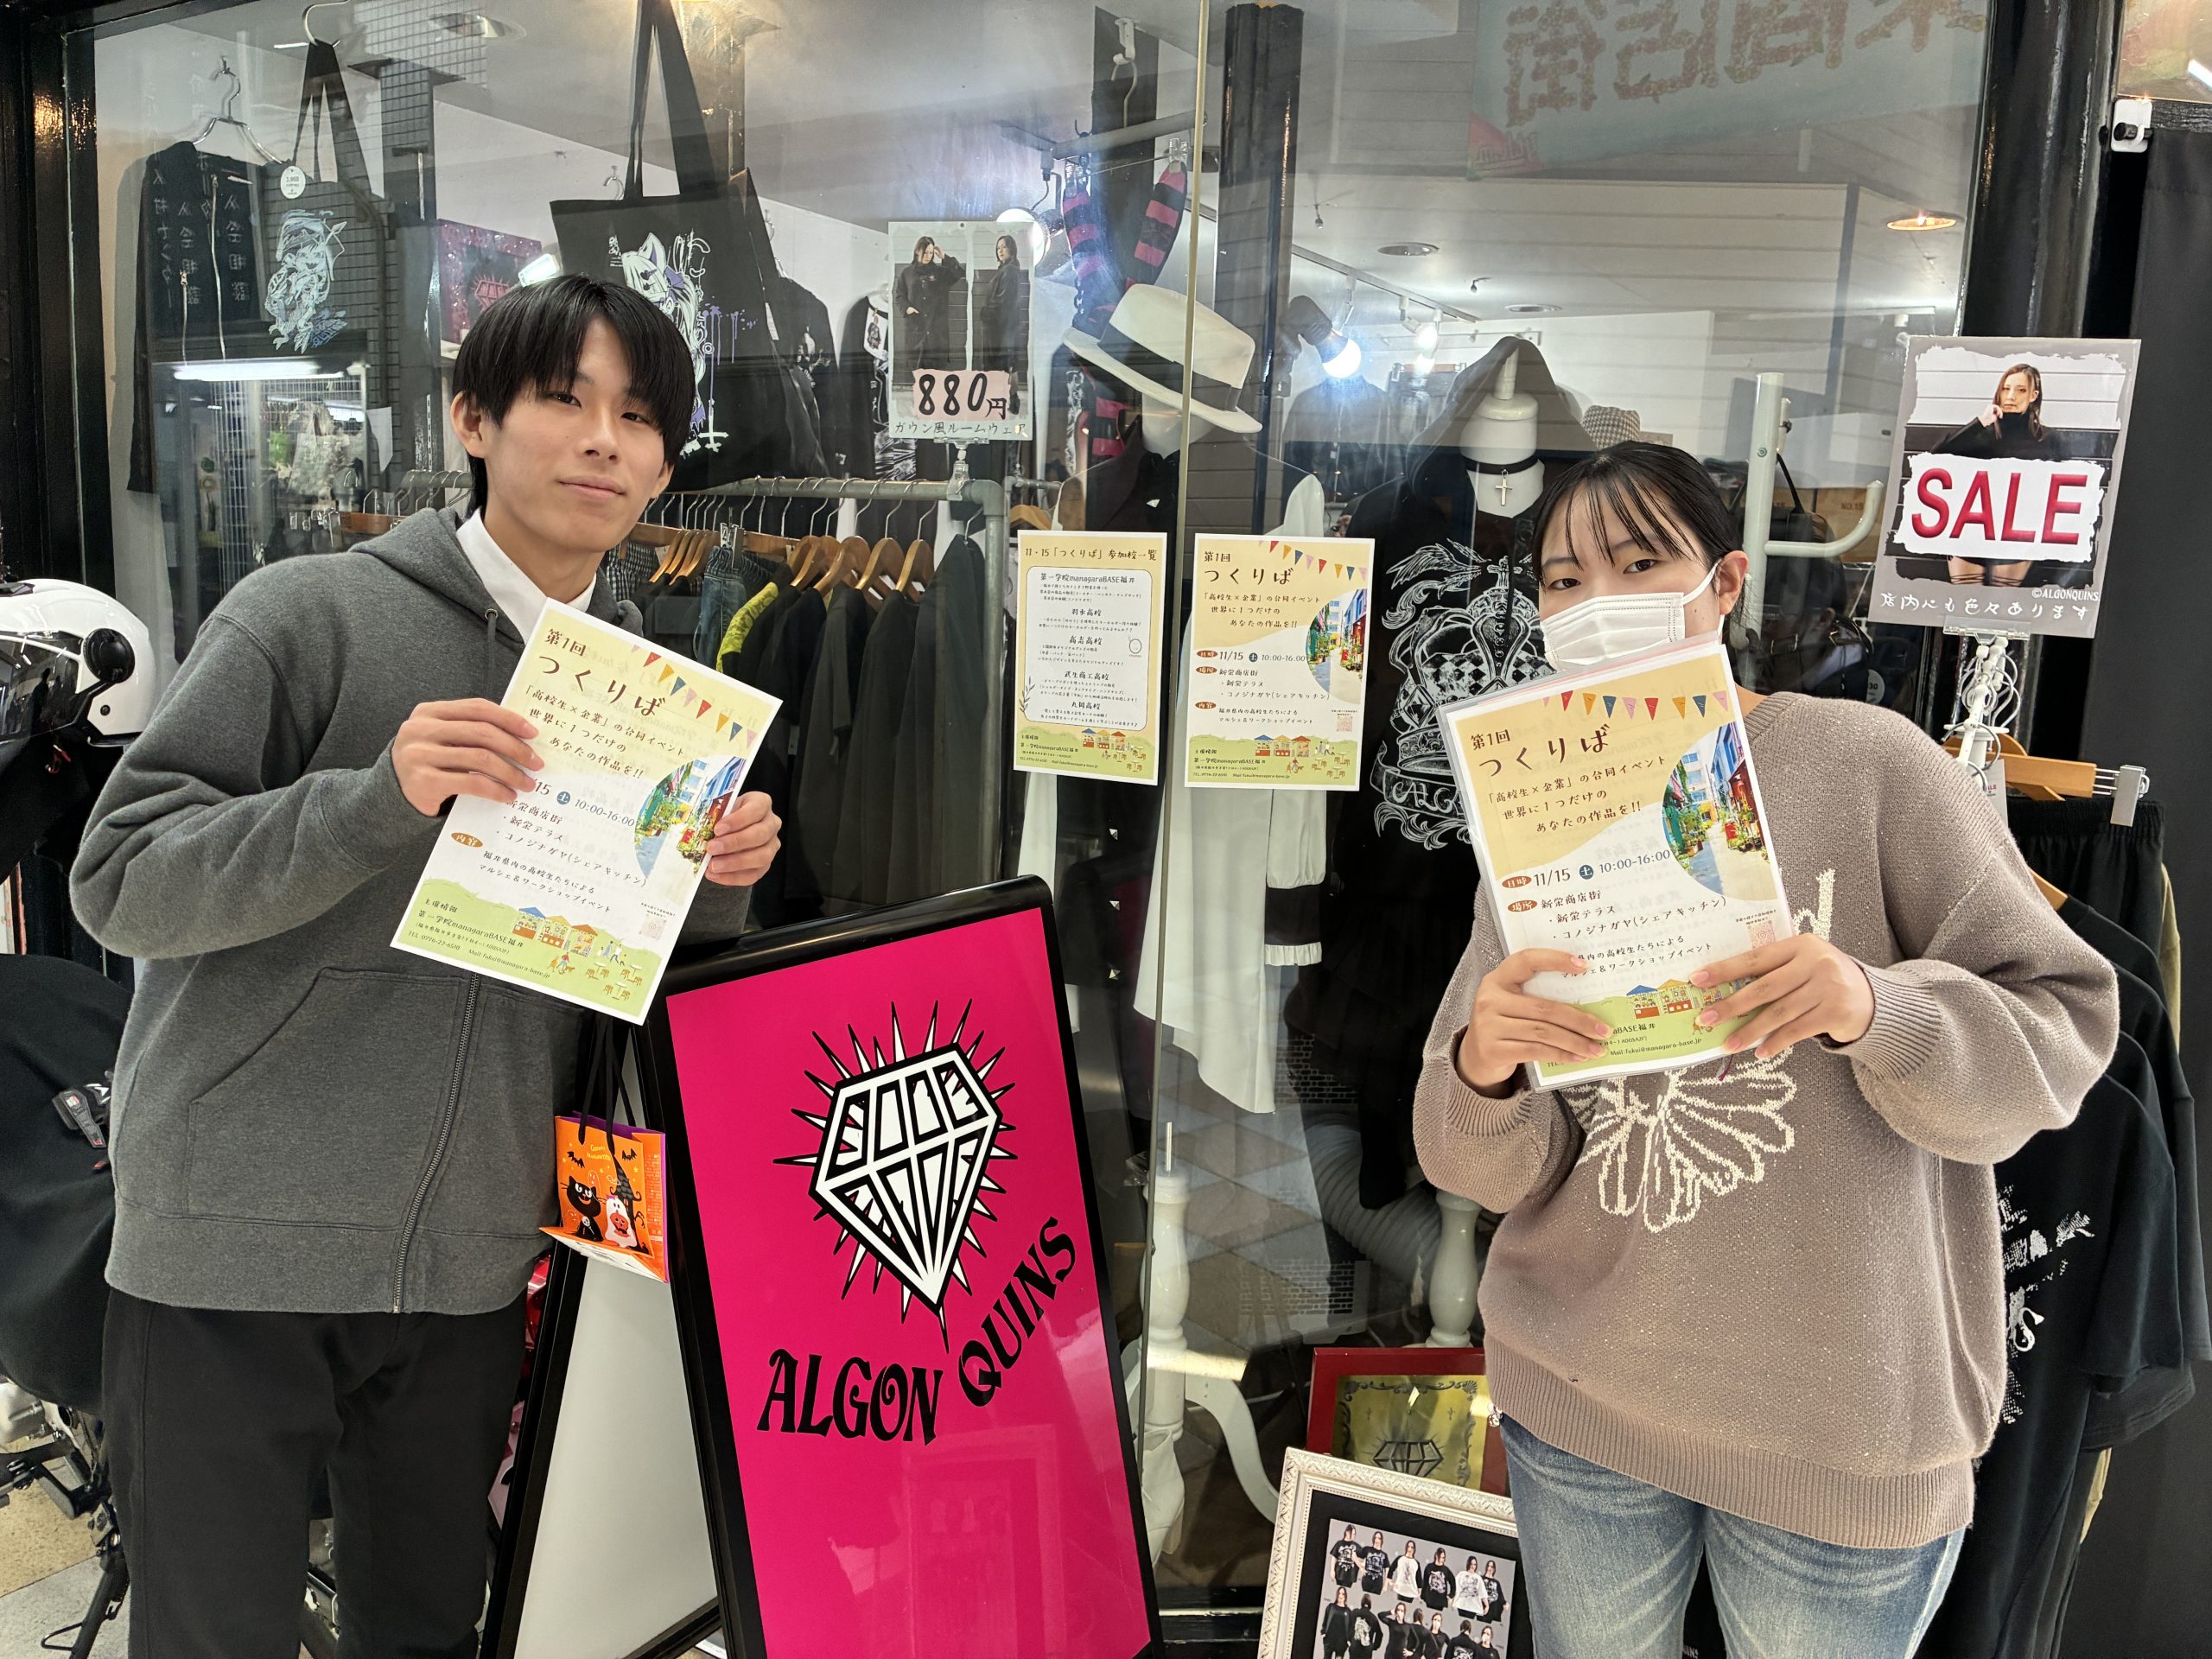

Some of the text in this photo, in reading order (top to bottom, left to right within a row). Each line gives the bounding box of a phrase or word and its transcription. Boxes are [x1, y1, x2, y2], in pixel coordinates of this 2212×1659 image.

[918, 372, 1007, 420] 880円
[1911, 467, 2088, 545] SALE
[1204, 550, 1230, 562] 第1回
[1040, 573, 1134, 583] 第一学院managaraBASE福井
[1204, 567, 1294, 585] つくりば
[544, 628, 586, 656] 第1回
[1219, 651, 1243, 661] 11/15
[538, 656, 665, 715] つくりば
[1064, 671, 1109, 680] 武生商工高校
[529, 708, 626, 752] 世界に1つだけの
[1471, 728, 1510, 750] 第1回
[1478, 723, 1609, 776] つくりば
[1489, 755, 1664, 803] 「高校生×企業」の合同イベント
[555, 790, 571, 805] 土
[575, 798, 634, 826] 10:00-16:00
[1503, 790, 1606, 819] 世界に1つだけの
[454, 832, 479, 848] 内容
[1506, 849, 1669, 889] 日時 11/15 土 10:00-16:00
[1510, 890, 1600, 912] 場所 新栄商店街
[756, 1217, 1077, 1446] ALGON QUINS
